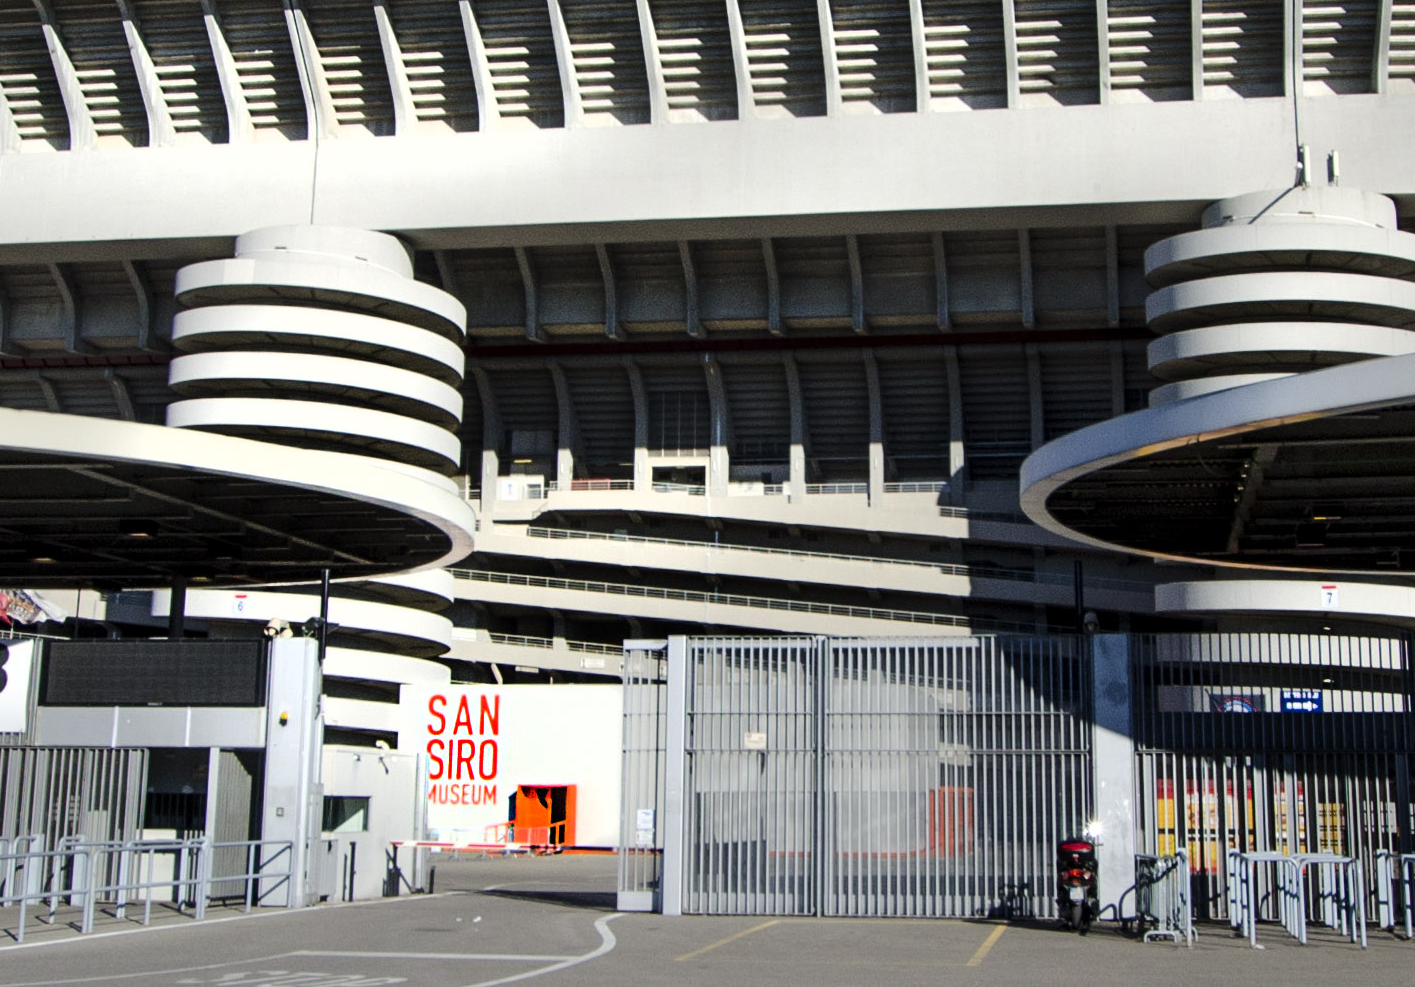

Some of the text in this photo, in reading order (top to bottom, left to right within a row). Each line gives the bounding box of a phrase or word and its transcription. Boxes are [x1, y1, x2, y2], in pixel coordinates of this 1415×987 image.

[1326, 592, 1333, 604] 7
[427, 694, 500, 736] SAN
[427, 739, 498, 781] SIRO
[428, 784, 497, 805] MUSEUM
